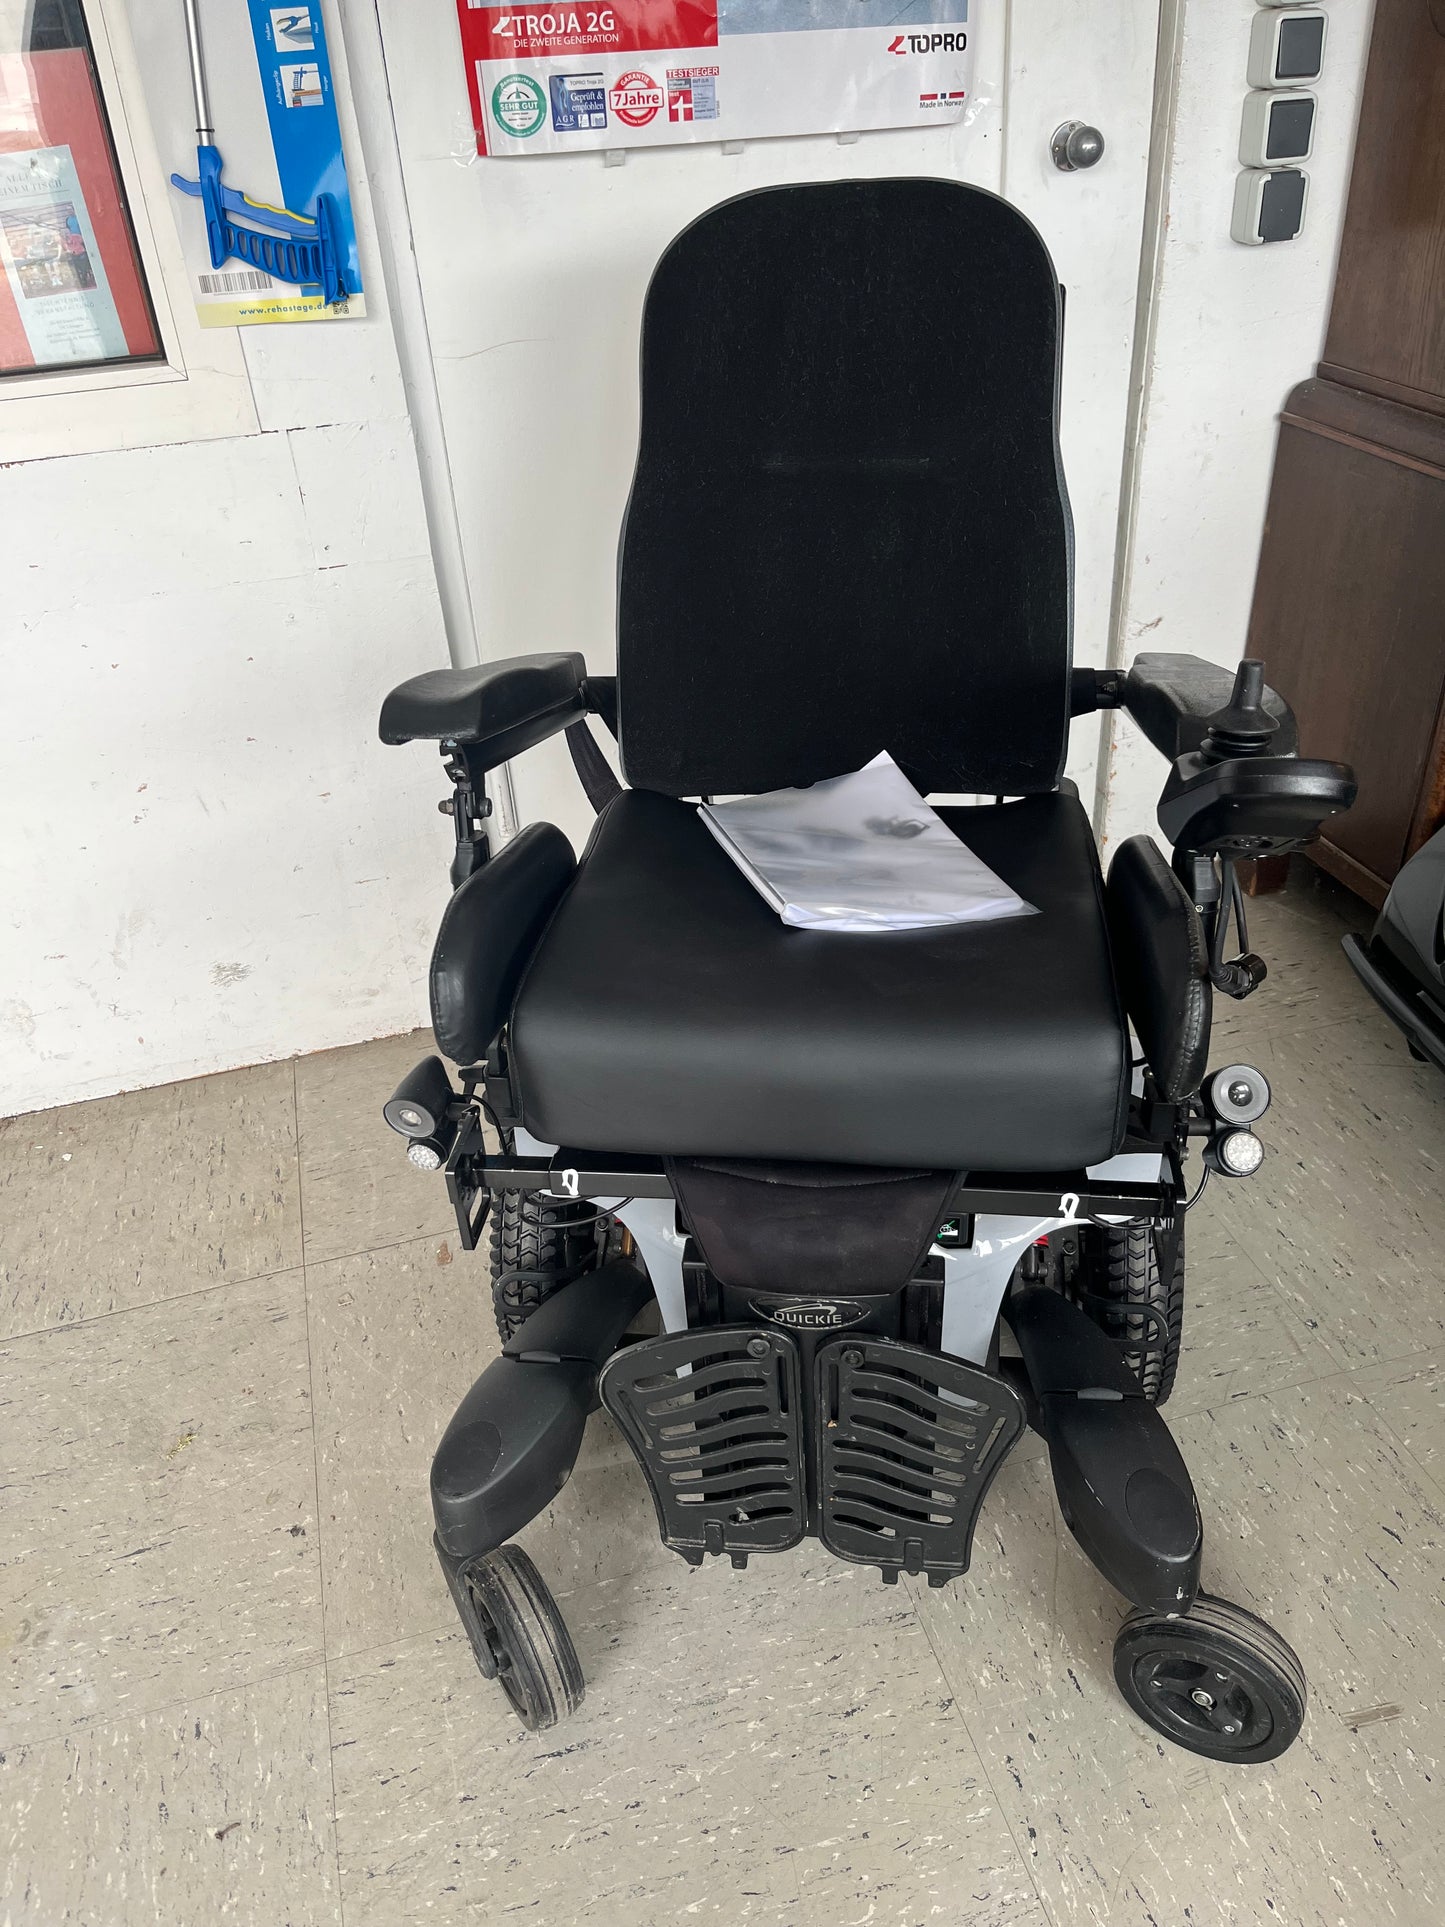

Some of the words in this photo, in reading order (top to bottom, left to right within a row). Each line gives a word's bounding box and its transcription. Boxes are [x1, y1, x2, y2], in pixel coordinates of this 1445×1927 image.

[512, 12, 582, 36] TROJA
[586, 10, 615, 32] 2G
[513, 38, 529, 49] DIE
[530, 36, 562, 47] ZWEITE
[563, 33, 619, 45] GENERATION
[907, 32, 967, 54] TOPRO
[667, 67, 719, 78] TESTSIEGER
[620, 73, 650, 86] GARANTIE
[570, 91, 595, 102] Geprüft
[597, 90, 604, 100] &
[500, 103, 520, 111] SEHR
[521, 101, 538, 110] GUT
[571, 101, 604, 113] empfohlen
[919, 101, 936, 109] Made
[944, 99, 964, 107] Norway
[774, 1311, 842, 1325] QUICKIE
